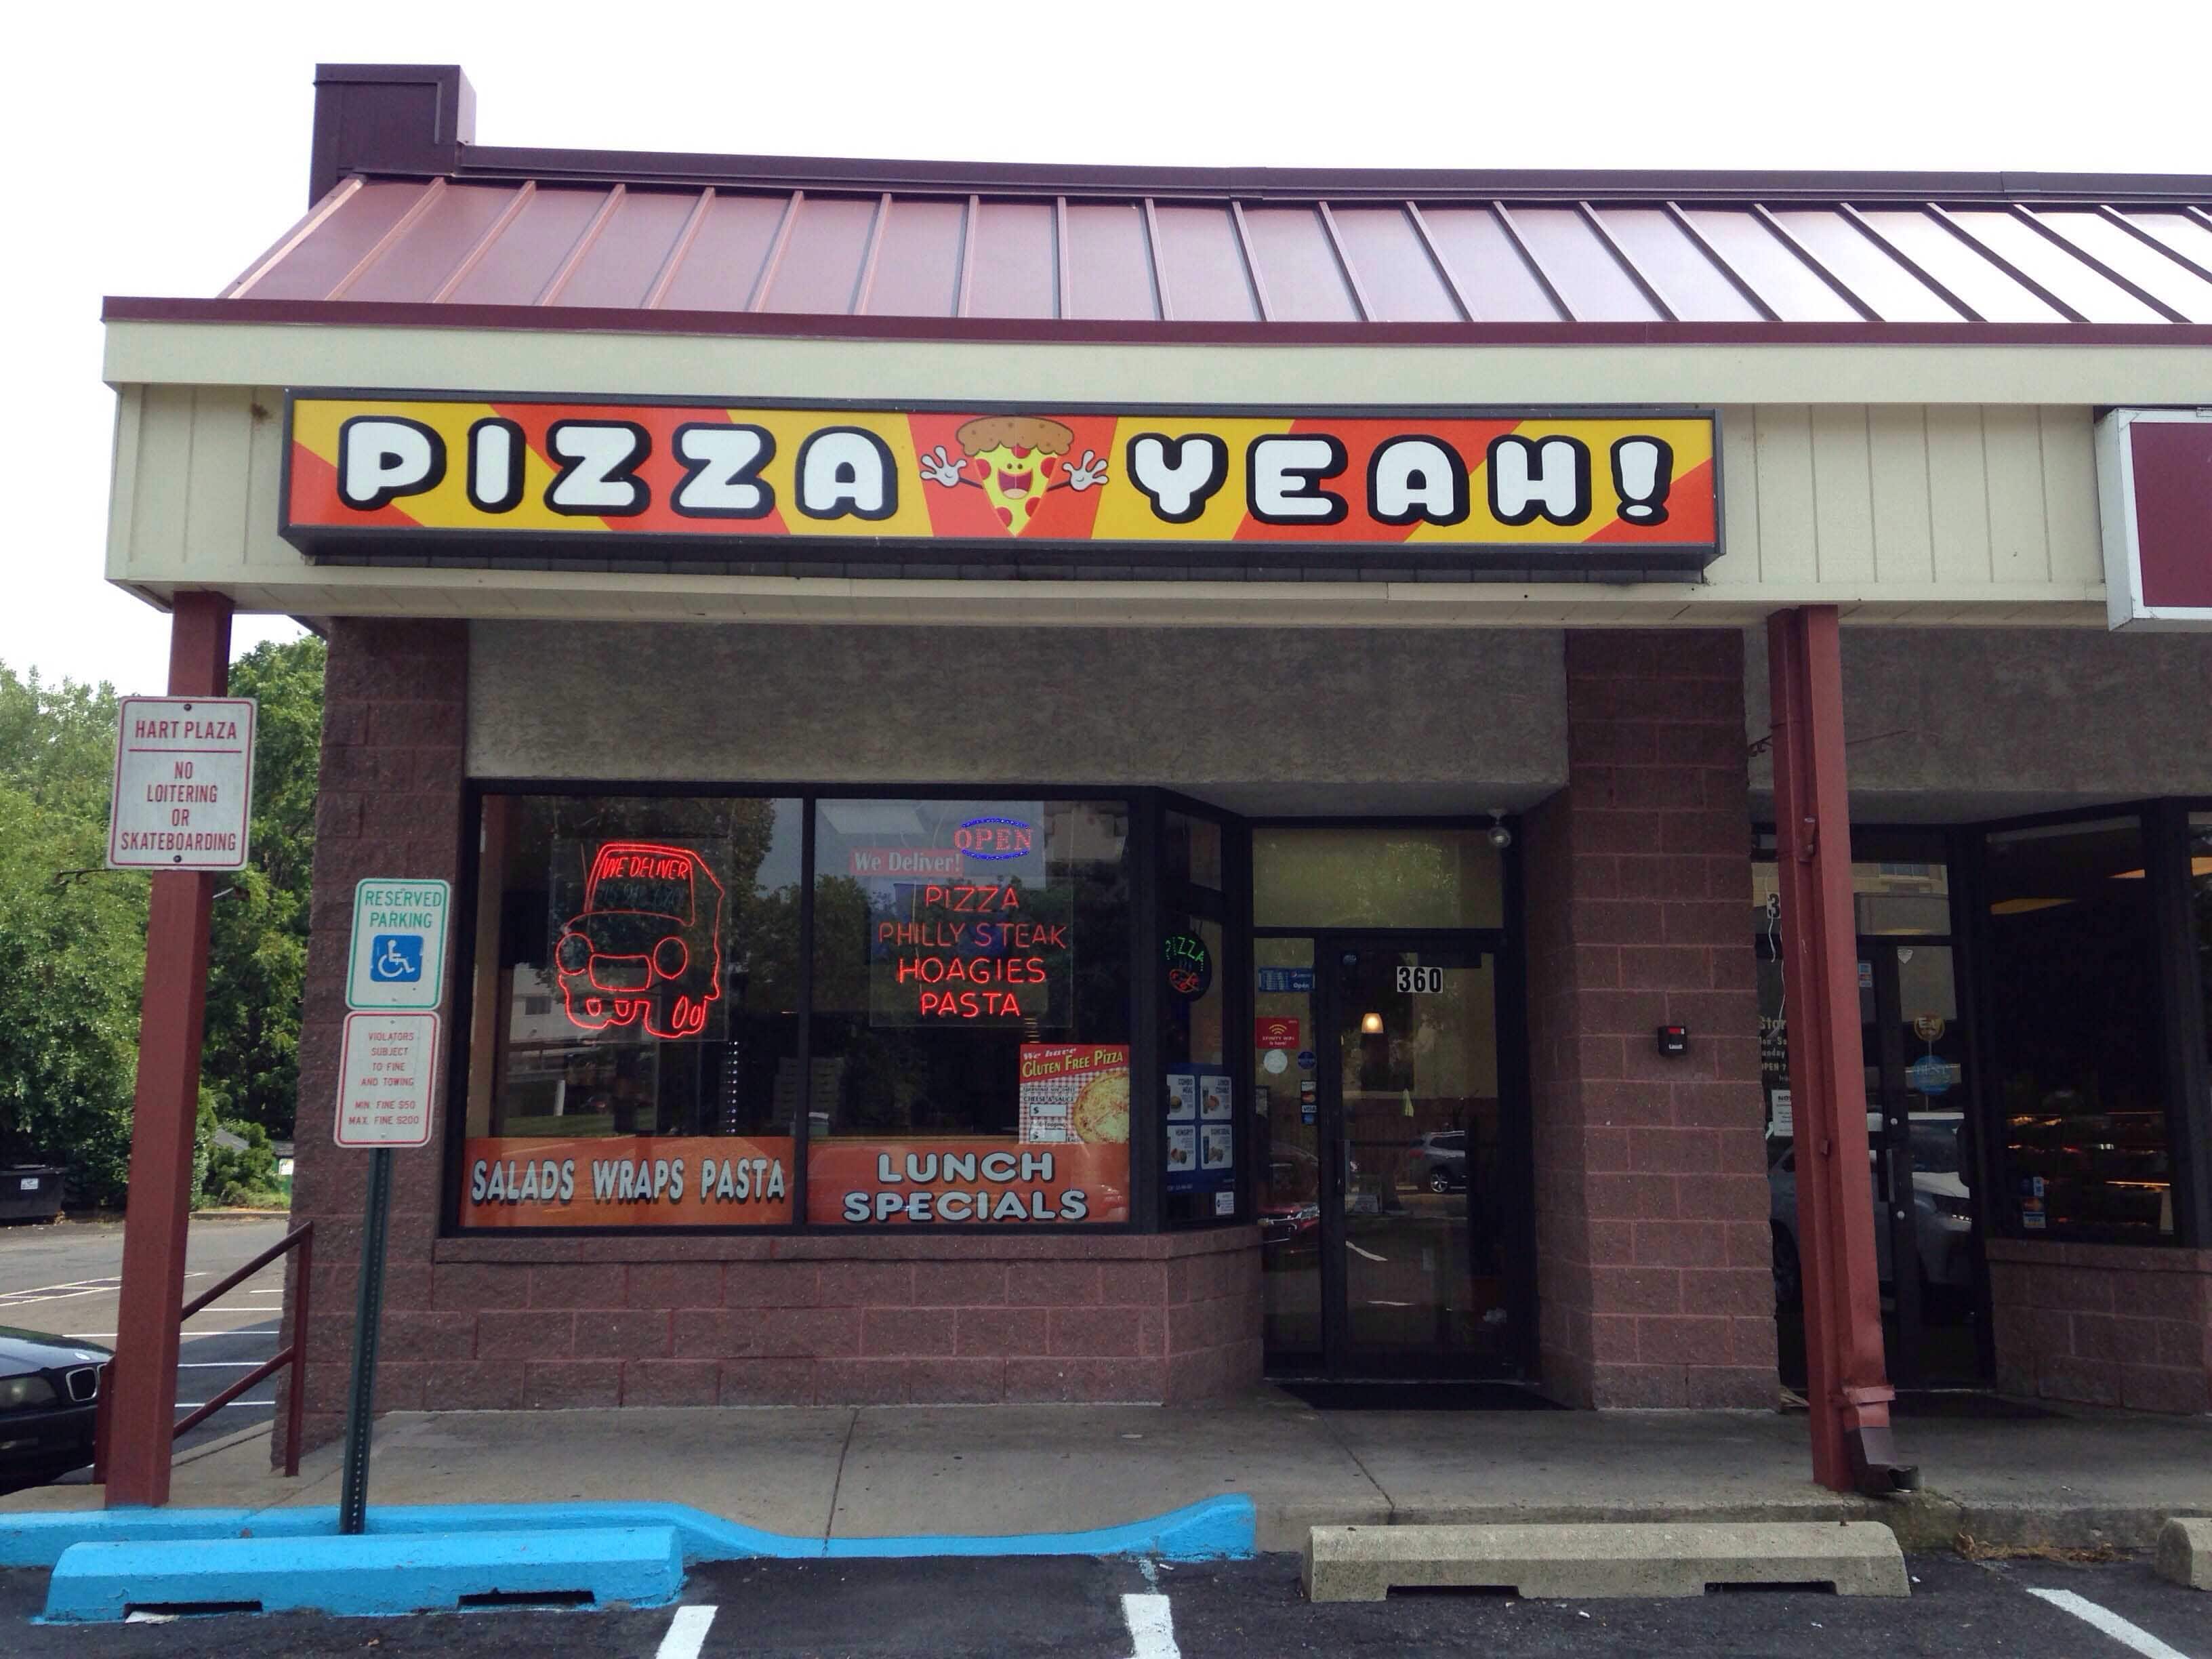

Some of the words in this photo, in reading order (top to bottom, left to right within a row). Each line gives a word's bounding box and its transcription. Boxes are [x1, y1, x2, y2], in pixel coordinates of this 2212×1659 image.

[337, 415, 899, 520] PIZZA
[1126, 432, 1674, 526] YEAH!
[135, 720, 179, 739] HART
[184, 721, 237, 739] PLAZA
[173, 761, 194, 779] NO
[146, 784, 218, 803] LOITERING
[171, 808, 190, 827] OR
[121, 832, 237, 851] SKATEBOARDING
[954, 828, 1033, 851] OPEN
[601, 856, 628, 880] WE
[630, 857, 689, 880] DELIVER
[855, 852, 882, 871] We
[888, 852, 961, 872] Deliver!
[365, 890, 442, 907] RESERVED
[924, 884, 1020, 913] PIZZA
[369, 912, 434, 929] PARKING
[878, 922, 966, 947] PHILLY
[974, 922, 1067, 949] STEAK
[898, 956, 1047, 984] HOAGIES
[1398, 966, 1442, 993] 360
[920, 991, 1021, 1018] PASTA
[1760, 1016, 1787, 1030] Stor
[368, 1032, 415, 1041] VIOLATORS
[371, 1047, 409, 1057] SUBJECT
[1023, 1052, 1041, 1060] We
[1045, 1048, 1077, 1057] have
[1761, 1050, 1786, 1059] unday
[373, 1062, 383, 1071] TO
[386, 1062, 405, 1071] FINE
[1065, 1054, 1090, 1071] FREE
[361, 1077, 378, 1086] AND
[383, 1077, 414, 1086] TOWING
[376, 1101, 396, 1110] FINE
[398, 1101, 415, 1110] $50
[374, 1116, 394, 1125] FINE
[395, 1116, 419, 1125] $200
[878, 1151, 1055, 1184] LUNCH
[472, 1158, 575, 1204] SALADS
[592, 1158, 684, 1204] WRAPS
[701, 1158, 785, 1204] PASTA
[843, 1189, 1088, 1222] SPECIALS
